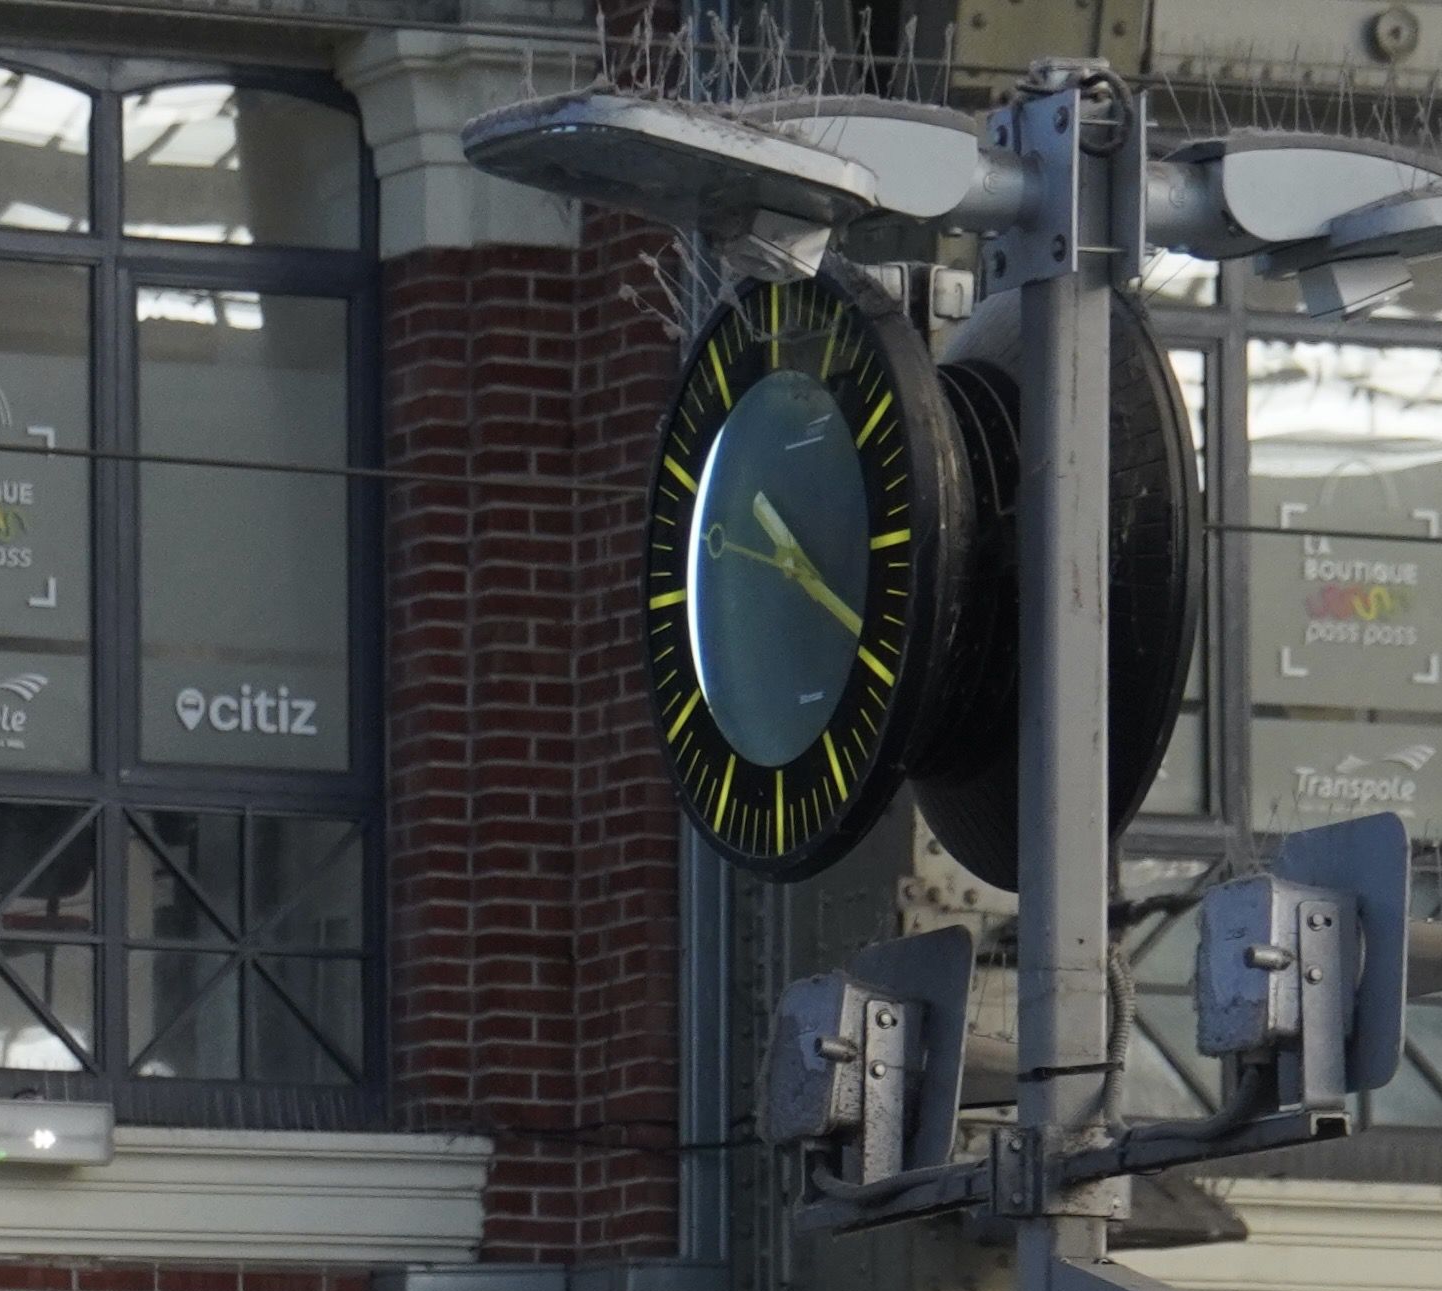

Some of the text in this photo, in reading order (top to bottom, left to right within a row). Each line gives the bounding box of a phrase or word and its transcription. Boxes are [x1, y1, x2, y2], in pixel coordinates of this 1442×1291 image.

[1304, 558, 1417, 584] BOUTIQUE
[207, 684, 318, 737] citiz
[1294, 766, 1416, 804] Transpole
